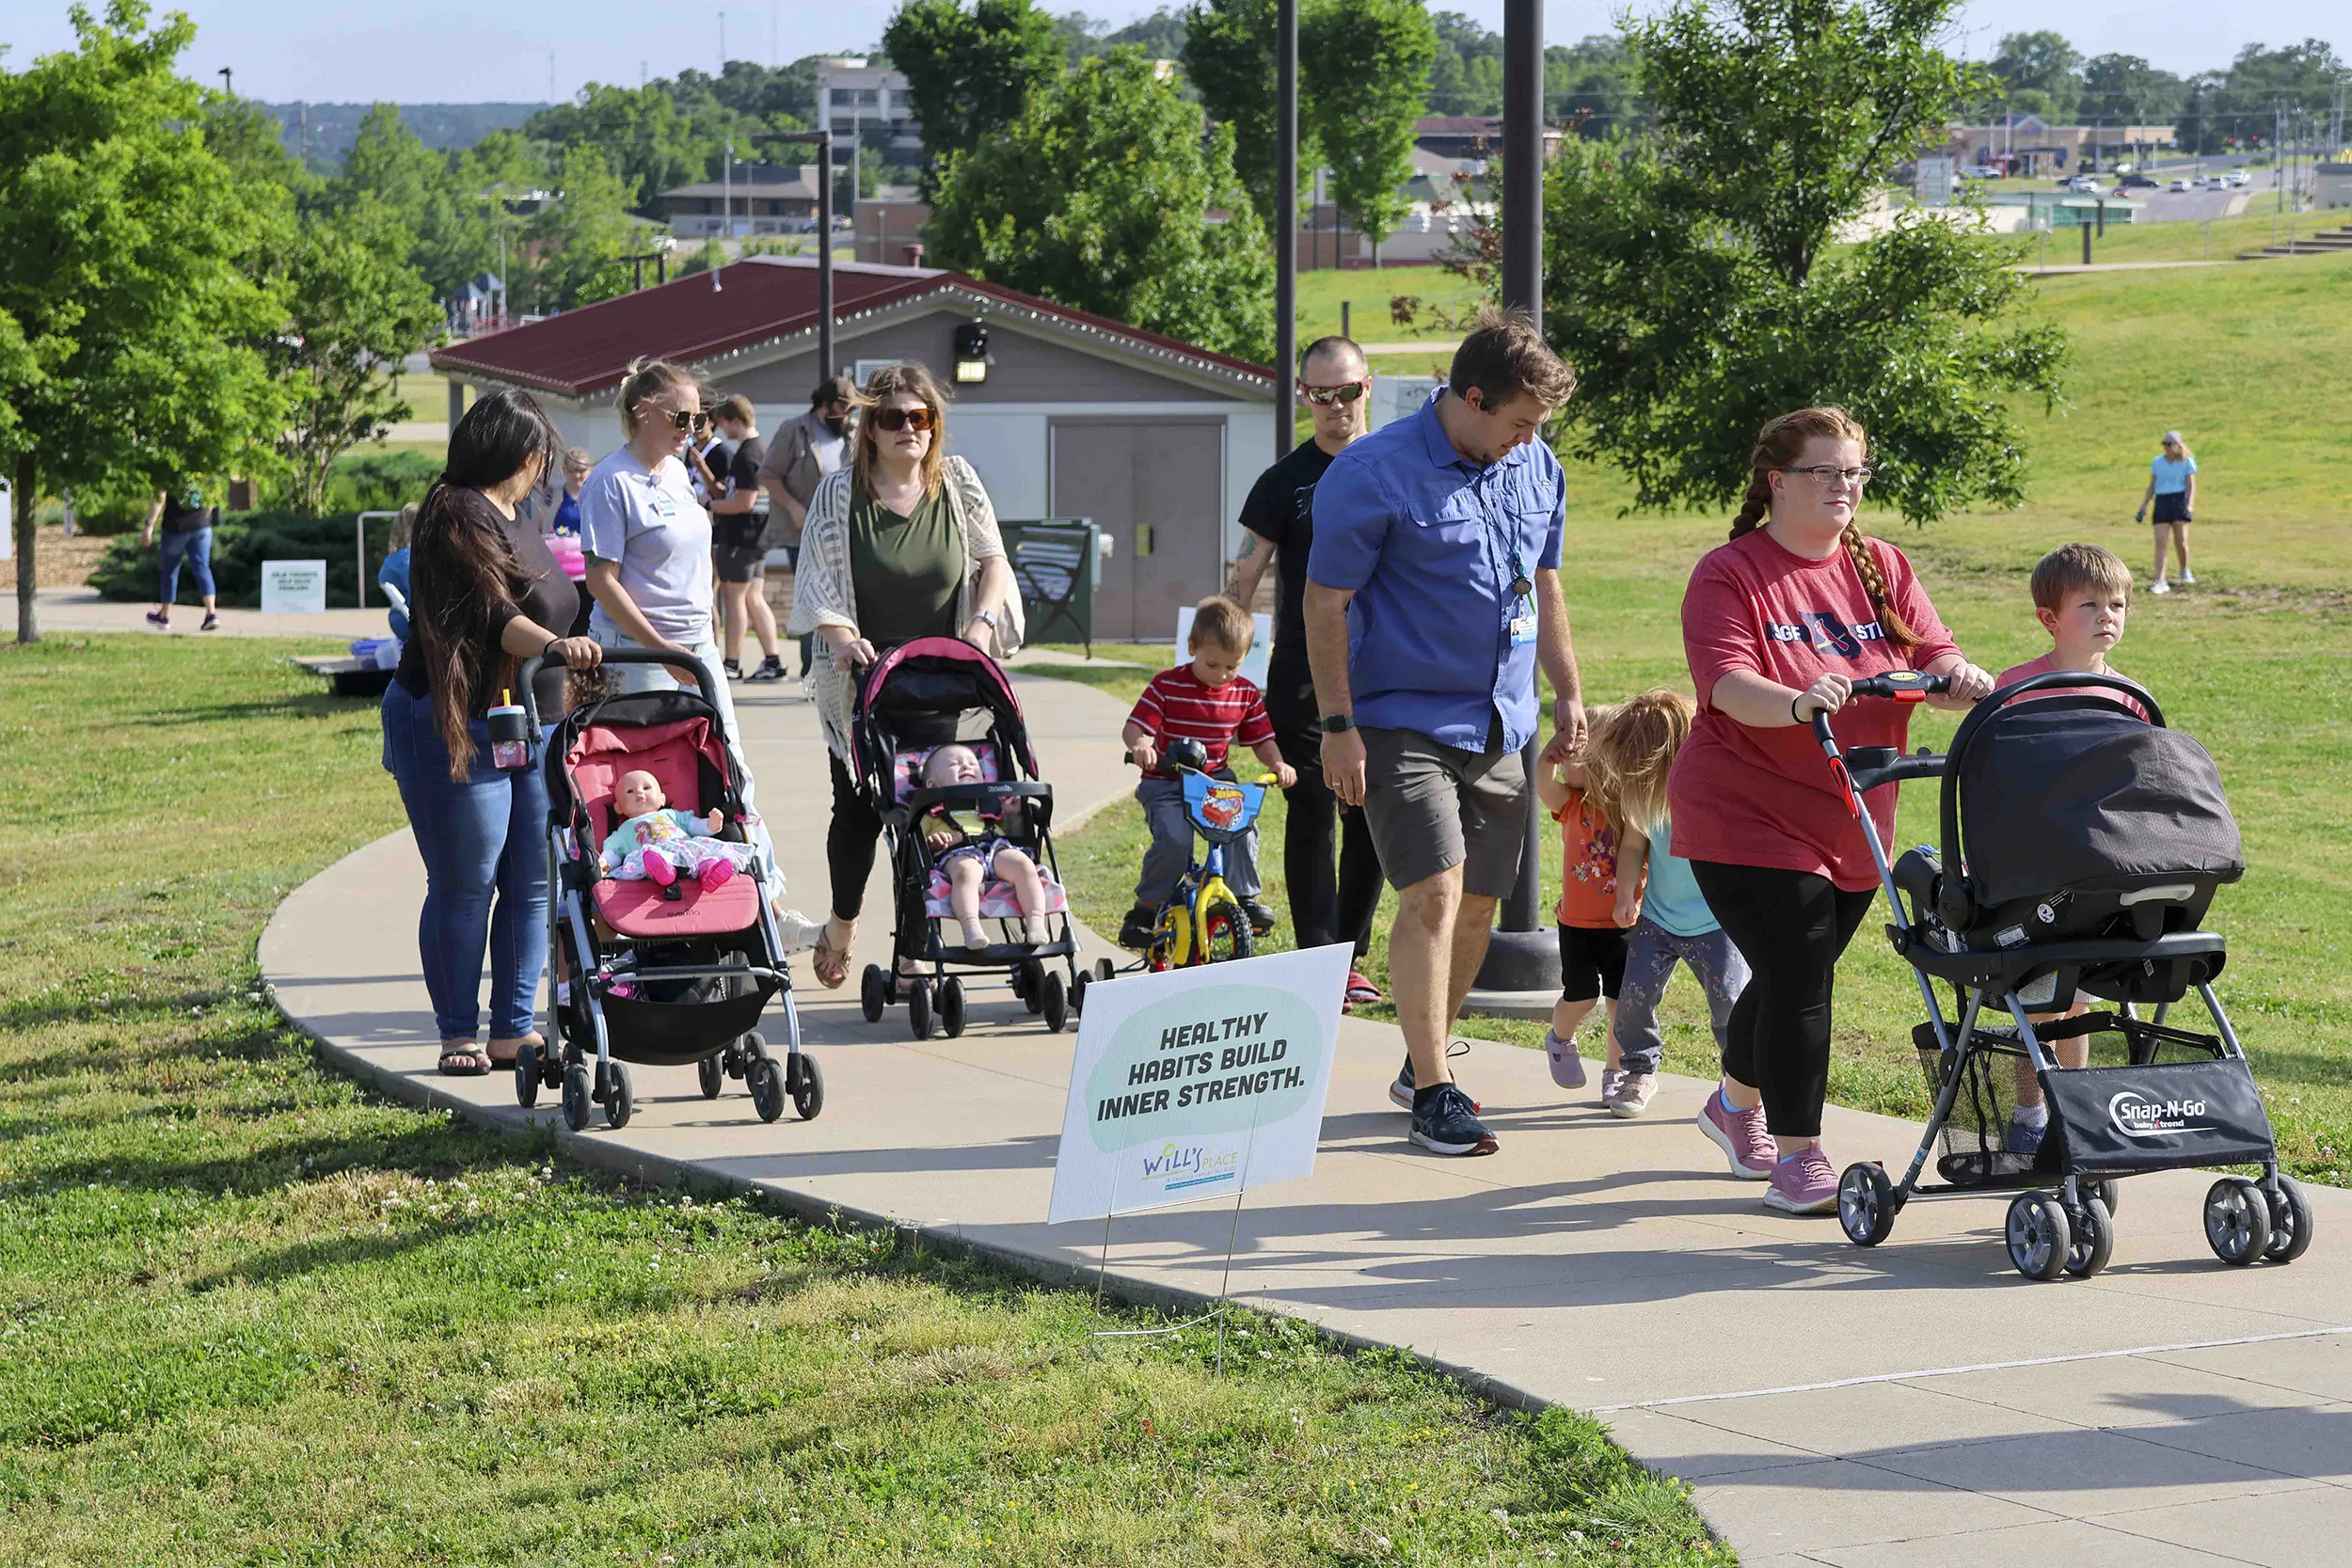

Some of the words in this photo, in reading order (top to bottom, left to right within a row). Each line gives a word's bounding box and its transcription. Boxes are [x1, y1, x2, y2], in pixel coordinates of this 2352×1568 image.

[1160, 1012, 1268, 1050] HEALTHY
[1128, 1052, 1214, 1085] HABITS
[1220, 1038, 1287, 1070] BUILD
[1097, 1089, 1169, 1121] INNER
[1177, 1066, 1305, 1108] STRENGTH.
[2122, 1100, 2206, 1121] Snap-N-Go
[2159, 1119, 2185, 1128] trend
[1202, 1152, 1238, 1169] PLACE
